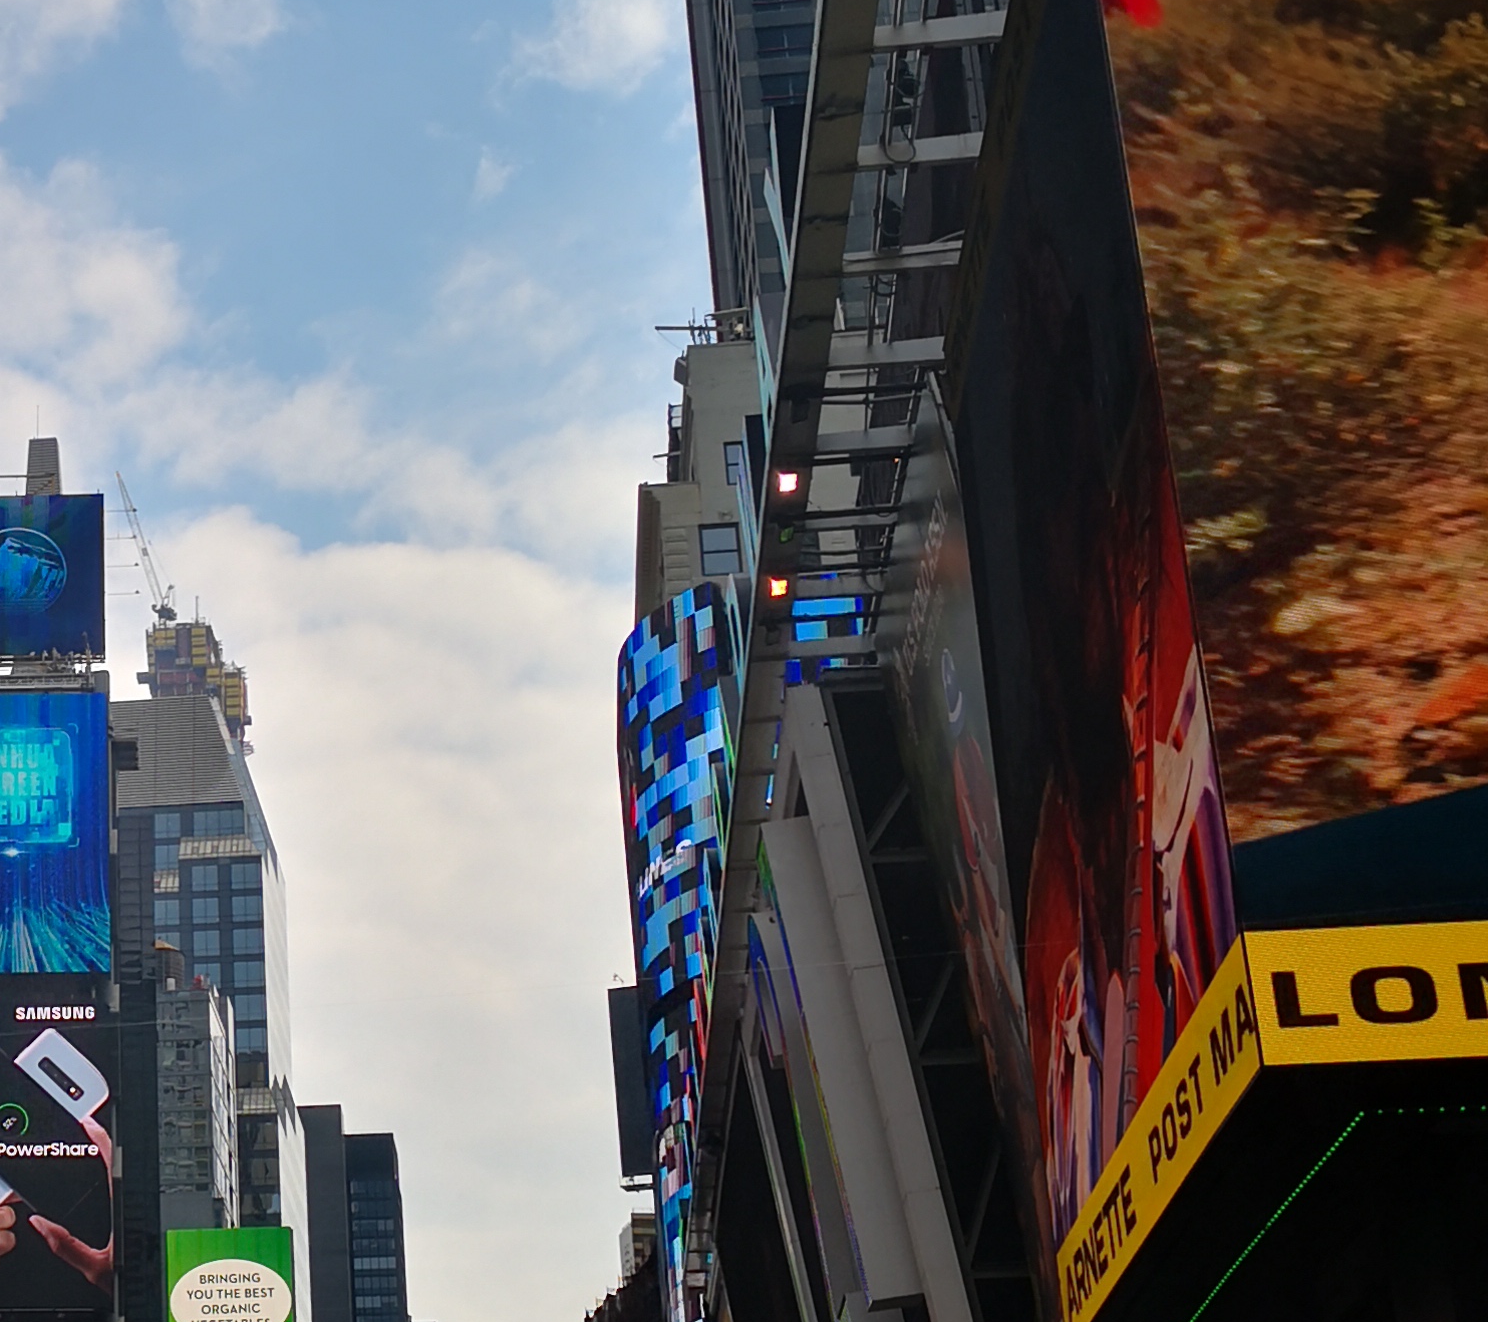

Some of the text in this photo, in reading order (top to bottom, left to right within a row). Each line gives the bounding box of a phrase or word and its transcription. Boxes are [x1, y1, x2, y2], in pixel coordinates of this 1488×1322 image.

[15, 1006, 96, 1021] SAMSUNG
[1147, 983, 1256, 1185] POST MA
[199, 1273, 261, 1285] BRINGING
[186, 1287, 275, 1300] YOU THE BEST
[201, 1303, 261, 1315] ORGANIC
